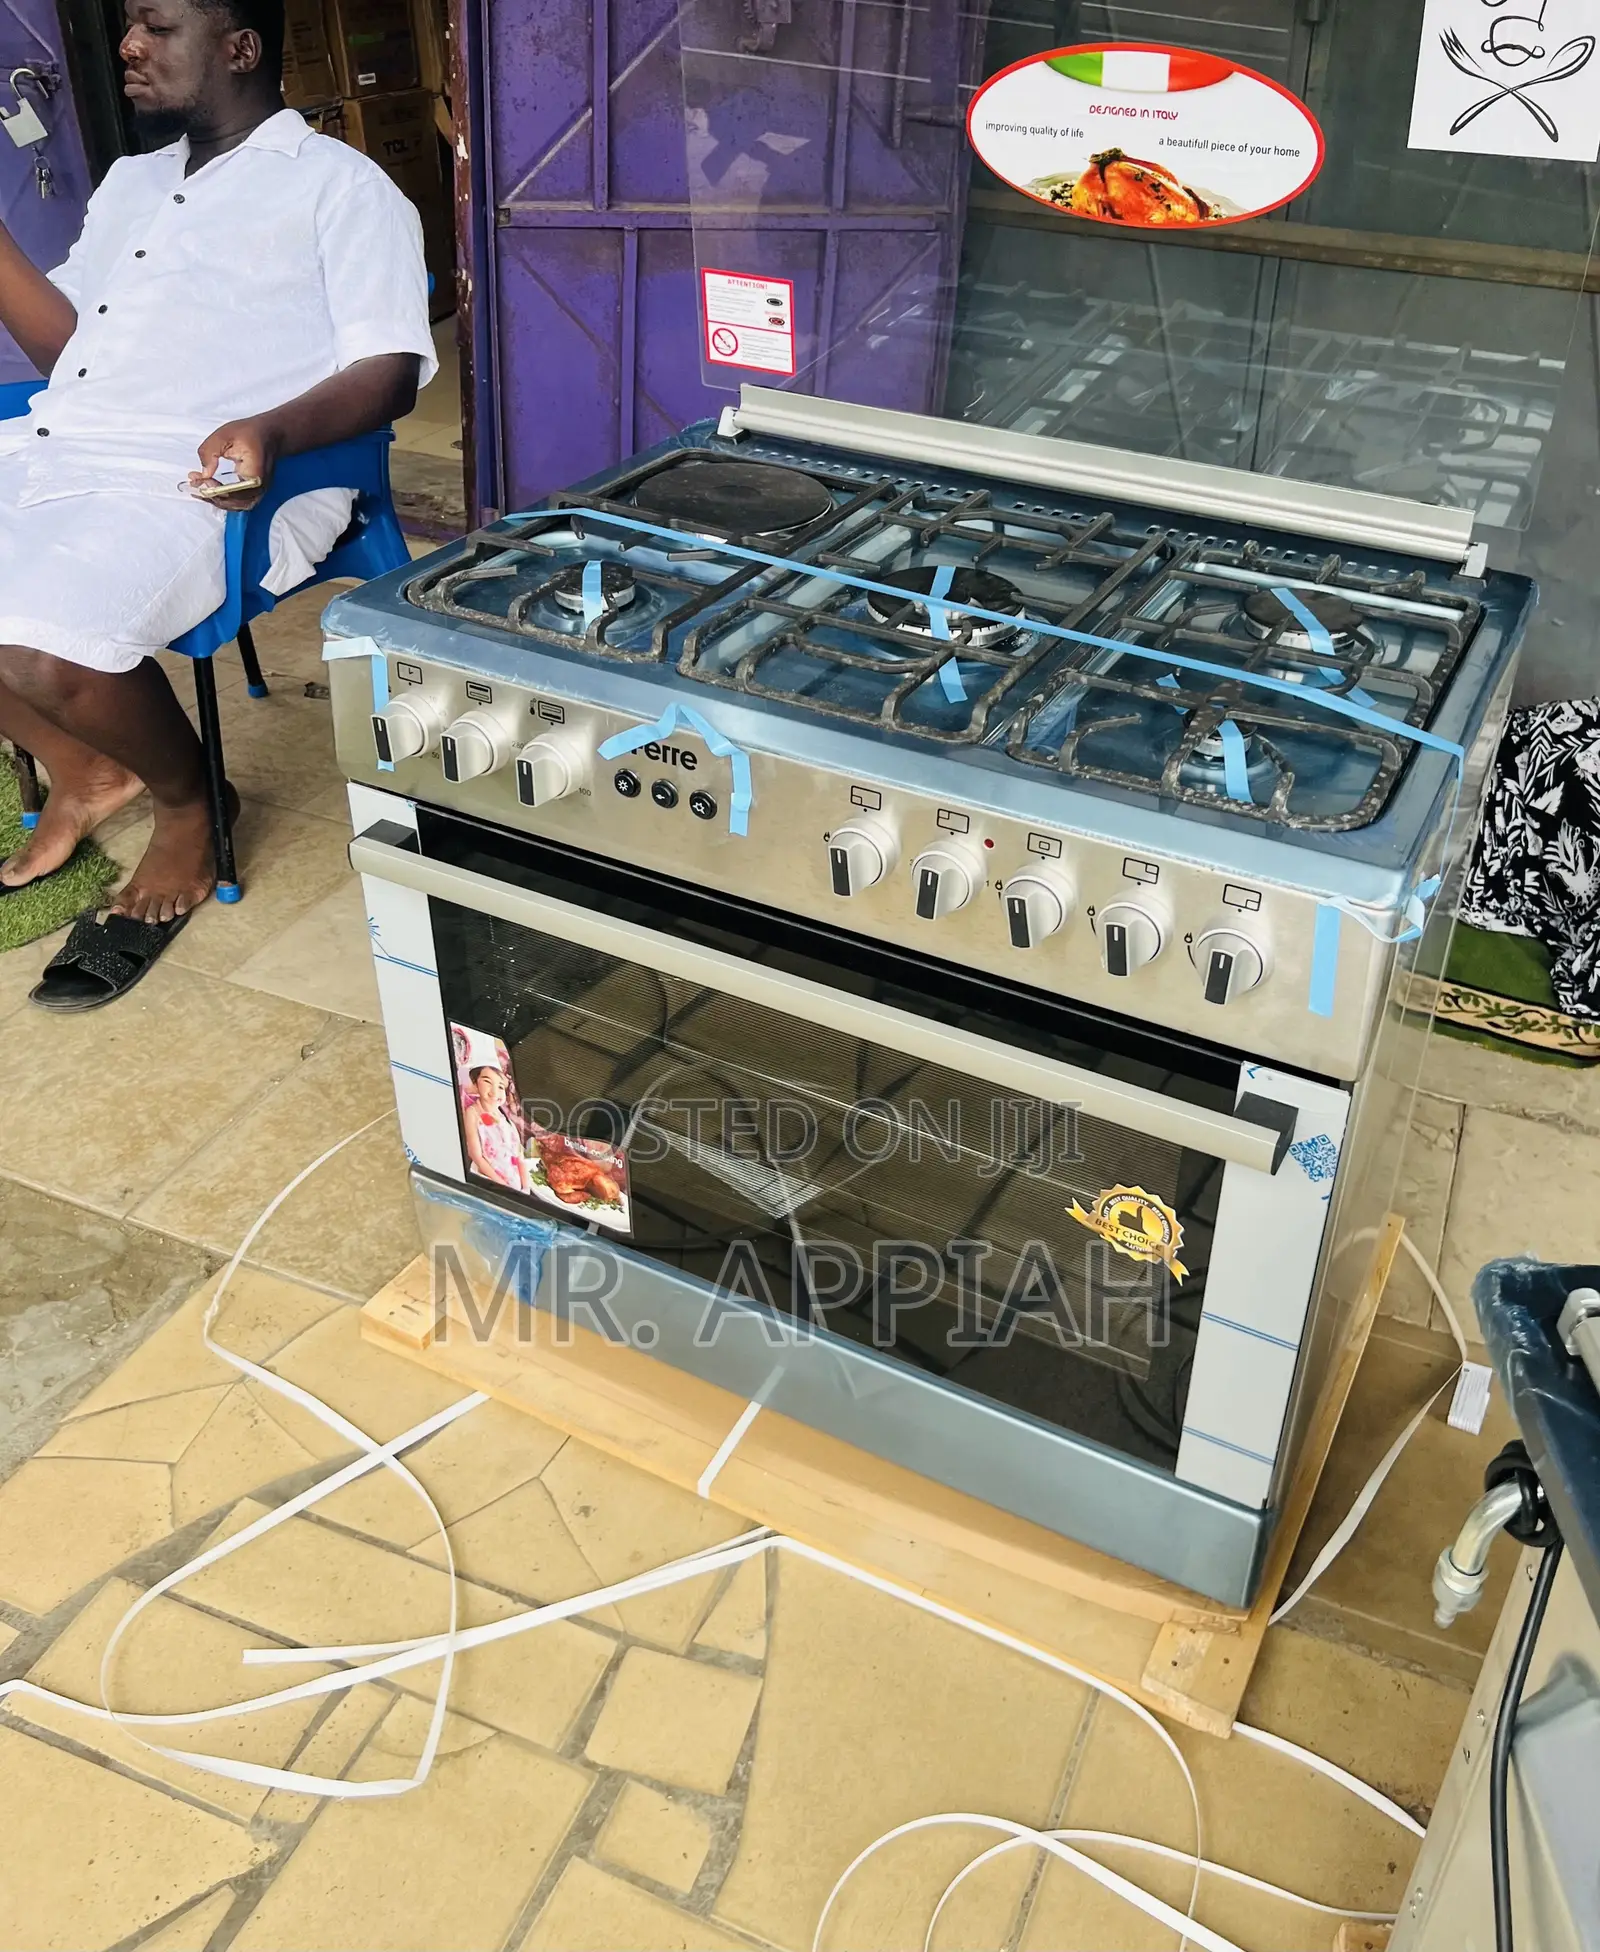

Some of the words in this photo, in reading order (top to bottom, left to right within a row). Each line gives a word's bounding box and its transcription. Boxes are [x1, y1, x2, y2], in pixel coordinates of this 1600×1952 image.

[1089, 104, 1138, 118] DESIGNED
[1139, 108, 1151, 118] IN
[1152, 109, 1179, 121] ITALY
[985, 121, 1028, 136] improving
[1029, 125, 1059, 139] quality
[1059, 127, 1070, 137] of
[1070, 127, 1085, 139] life
[382, 138, 408, 157] TCL
[1158, 138, 1165, 146] a
[1166, 136, 1209, 151] beautifull
[1210, 142, 1236, 155] piece
[1238, 142, 1249, 153] of
[1249, 146, 1272, 157] your
[1273, 145, 1301, 158] home
[727, 278, 769, 290] ATTENTION!
[578, 787, 592, 797] 100
[1095, 1218, 1120, 1234] BEST
[1122, 1229, 1162, 1252] CHOICE
